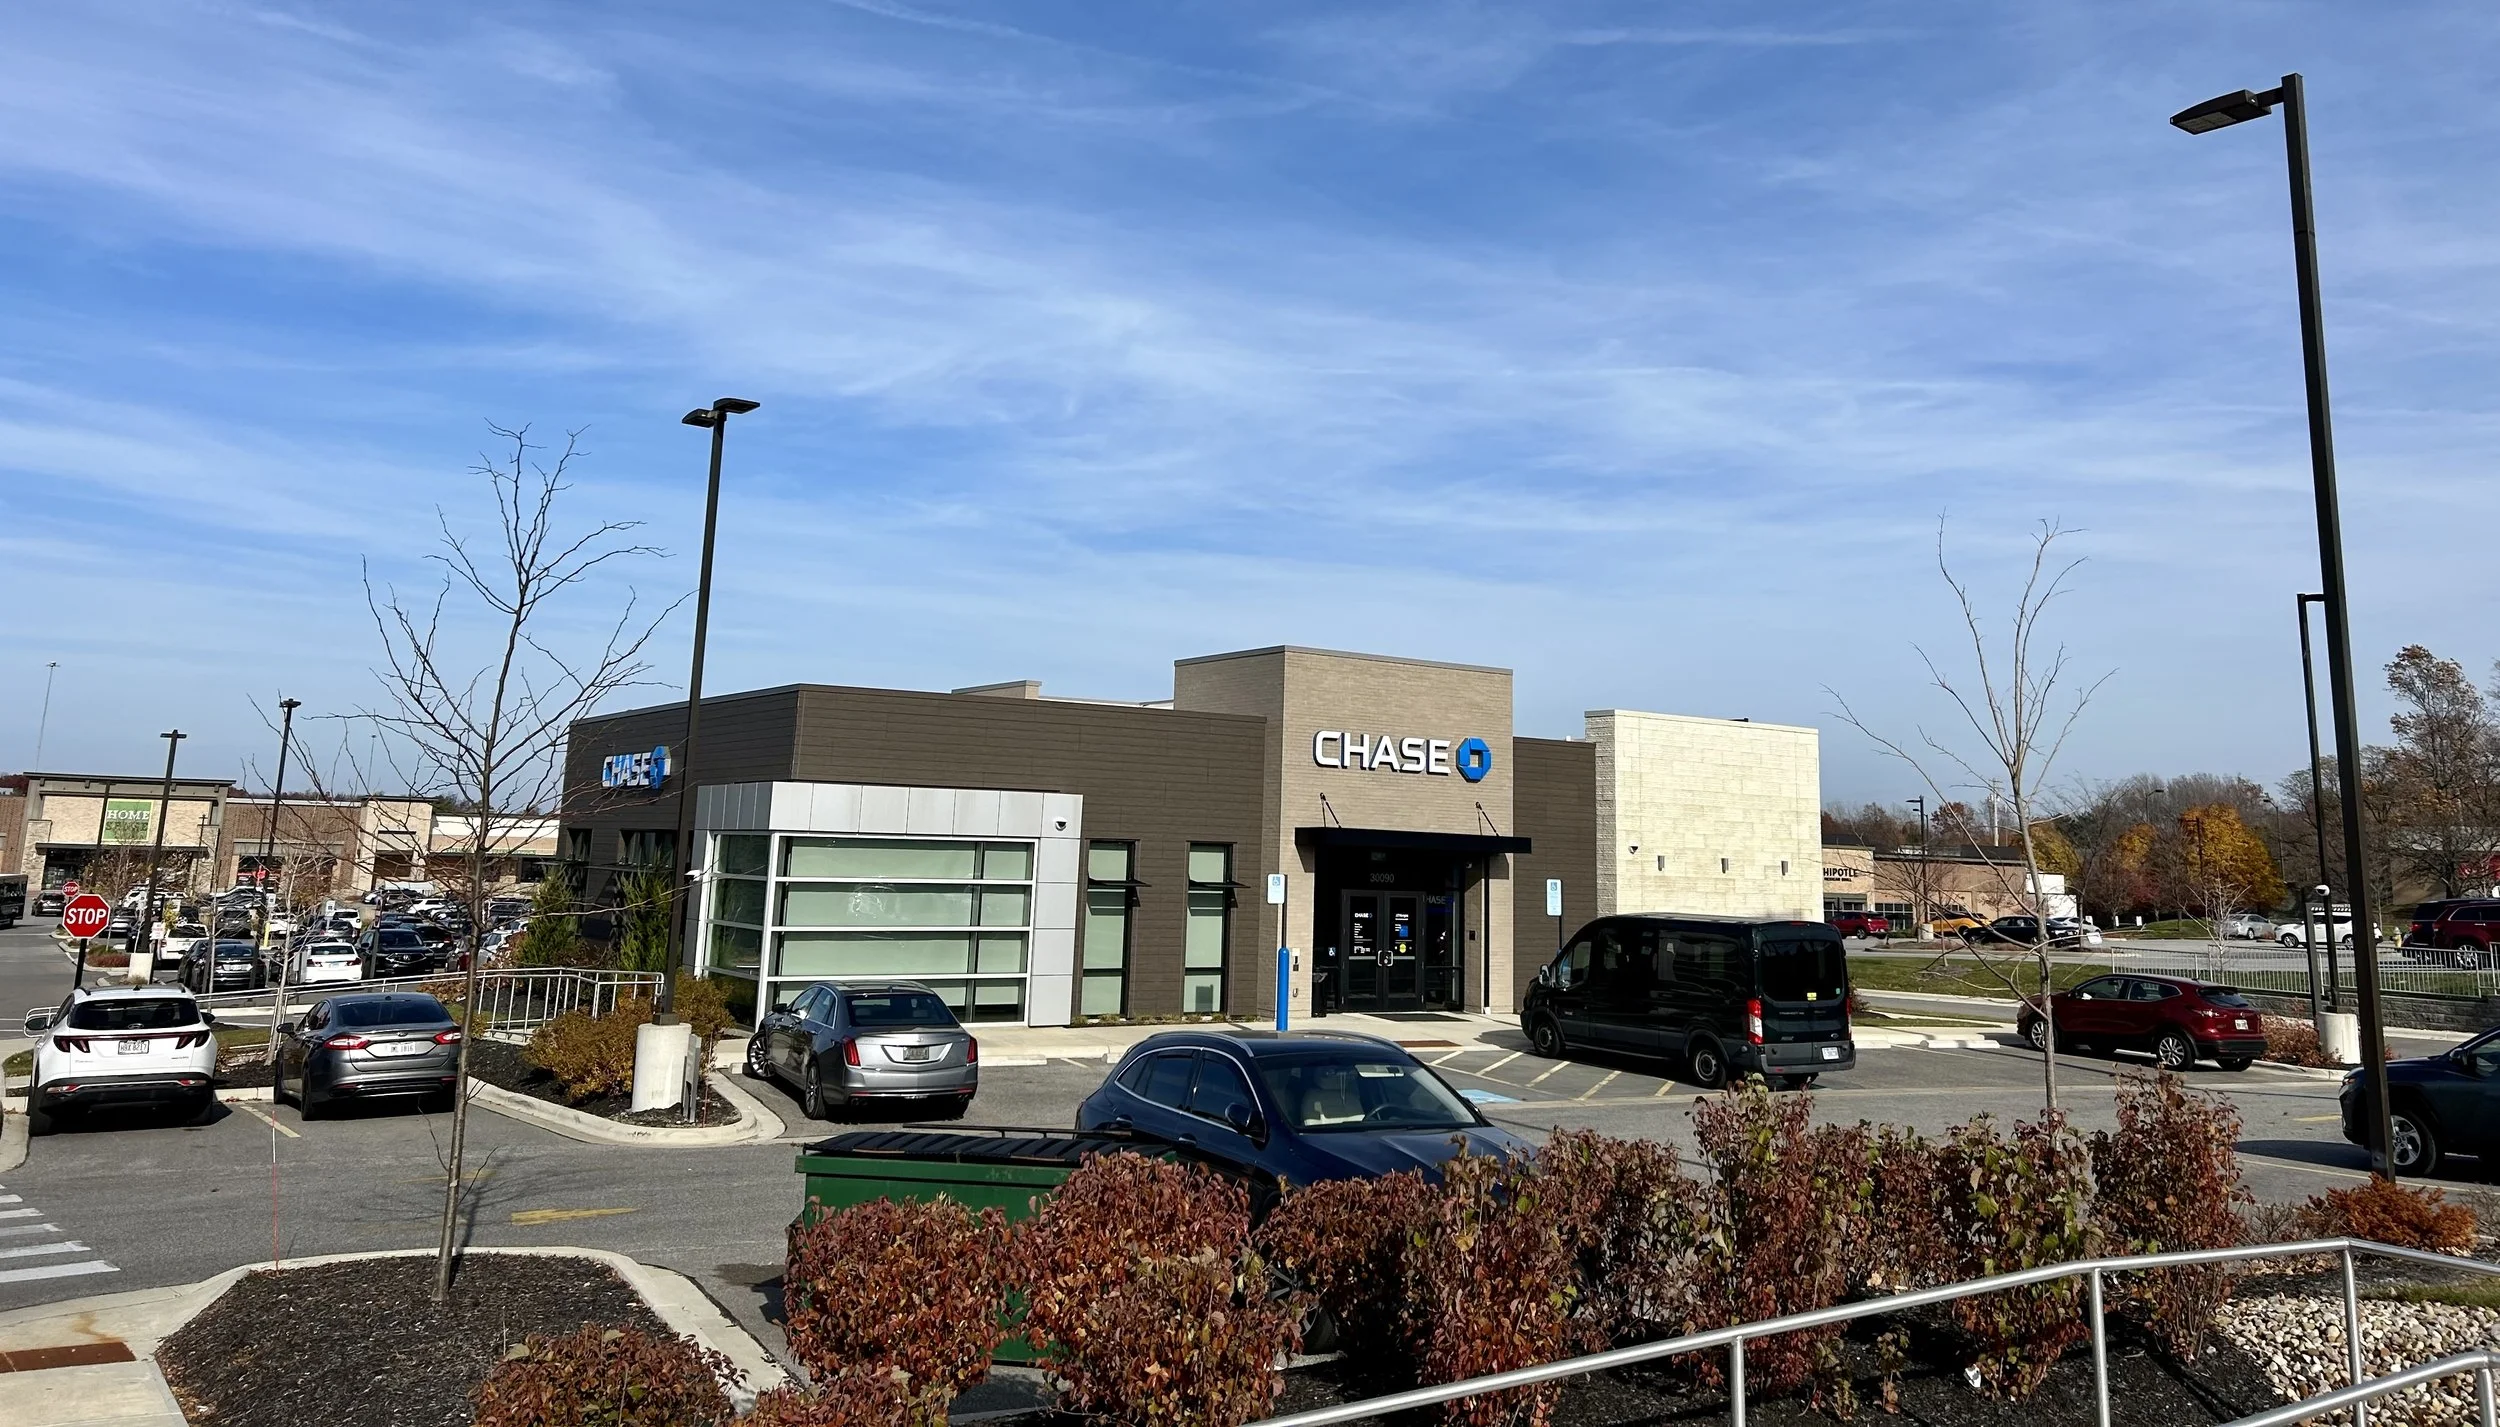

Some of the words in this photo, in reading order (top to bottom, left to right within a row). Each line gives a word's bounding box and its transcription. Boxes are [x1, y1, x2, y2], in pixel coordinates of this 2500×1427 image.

[1313, 730, 1452, 776] CHASE
[602, 752, 652, 788] CHASE
[106, 809, 150, 820] HOME
[1370, 873, 1395, 883] 30090
[1823, 867, 1859, 878] HIPOTLE
[66, 908, 107, 925] STOP
